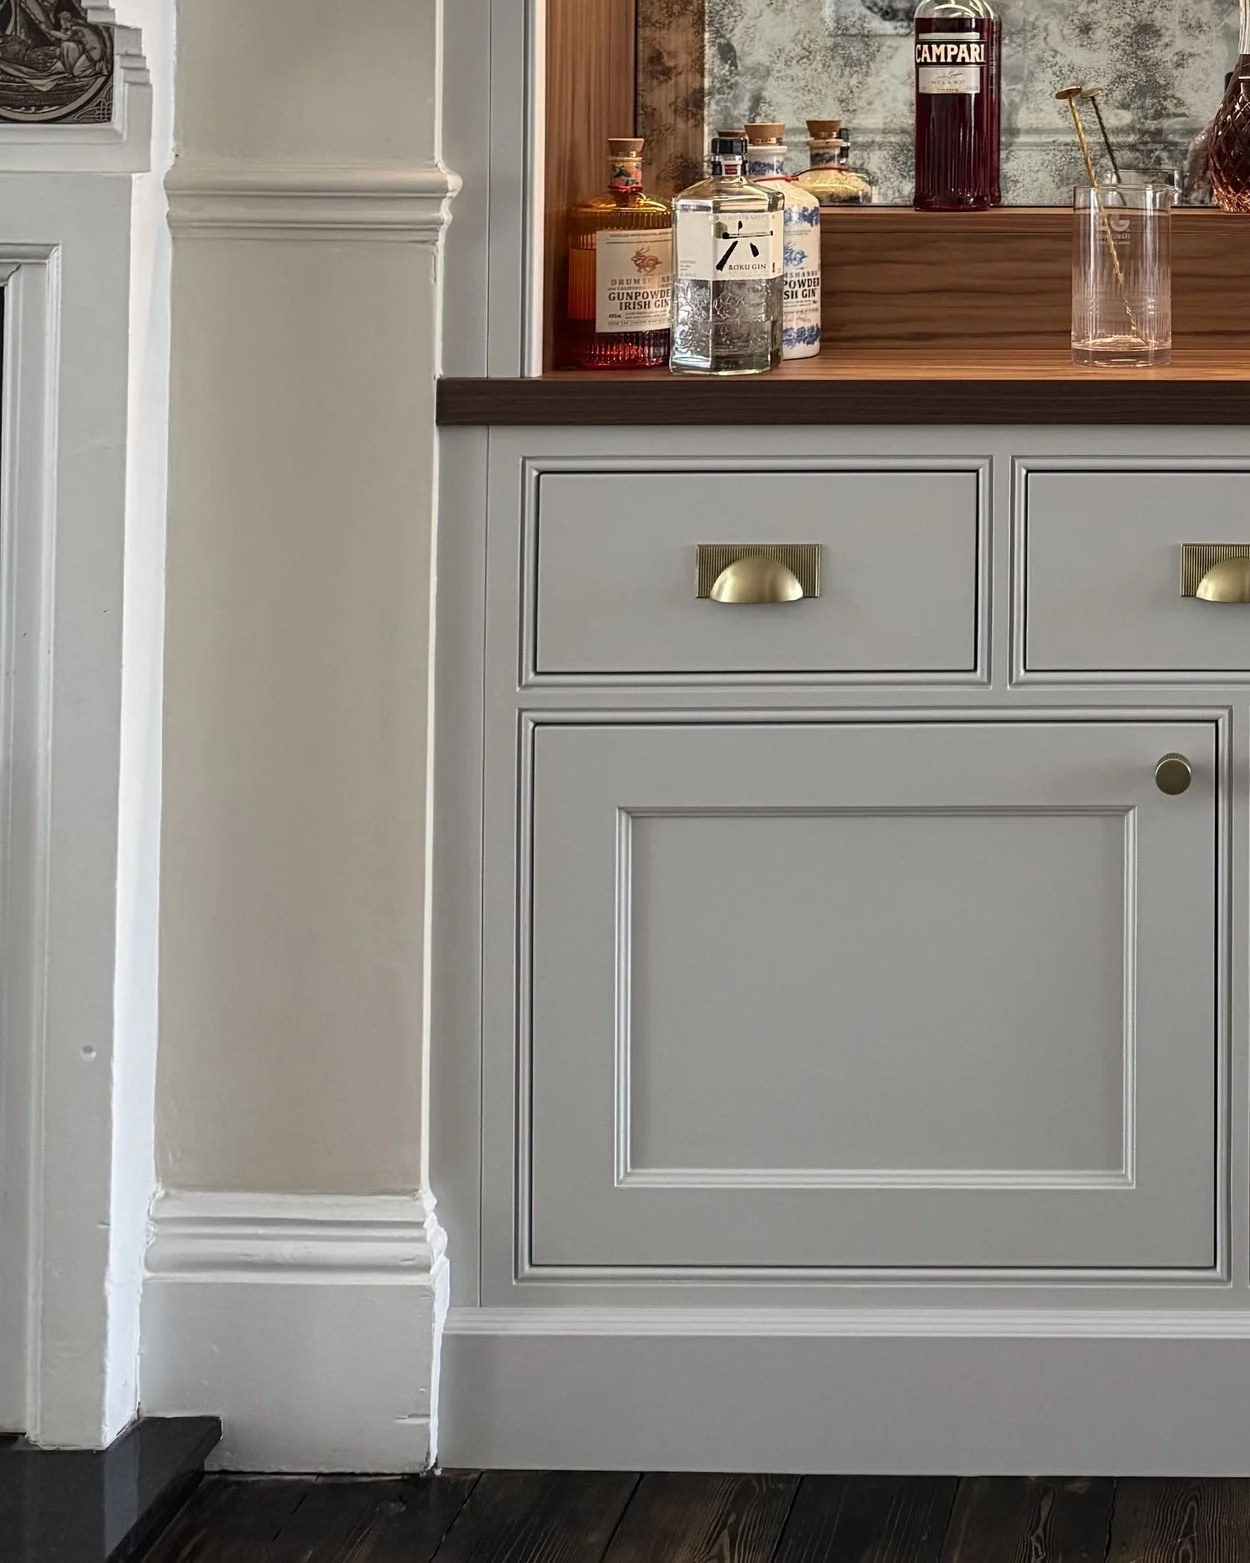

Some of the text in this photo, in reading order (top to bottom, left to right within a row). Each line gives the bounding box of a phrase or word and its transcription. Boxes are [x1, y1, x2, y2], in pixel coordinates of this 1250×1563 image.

[915, 43, 985, 63] CAMPARI
[783, 277, 820, 290] POWDER
[608, 288, 671, 301] GUNPOWDE
[801, 288, 816, 299] GIN
[619, 300, 651, 311] IRISH
